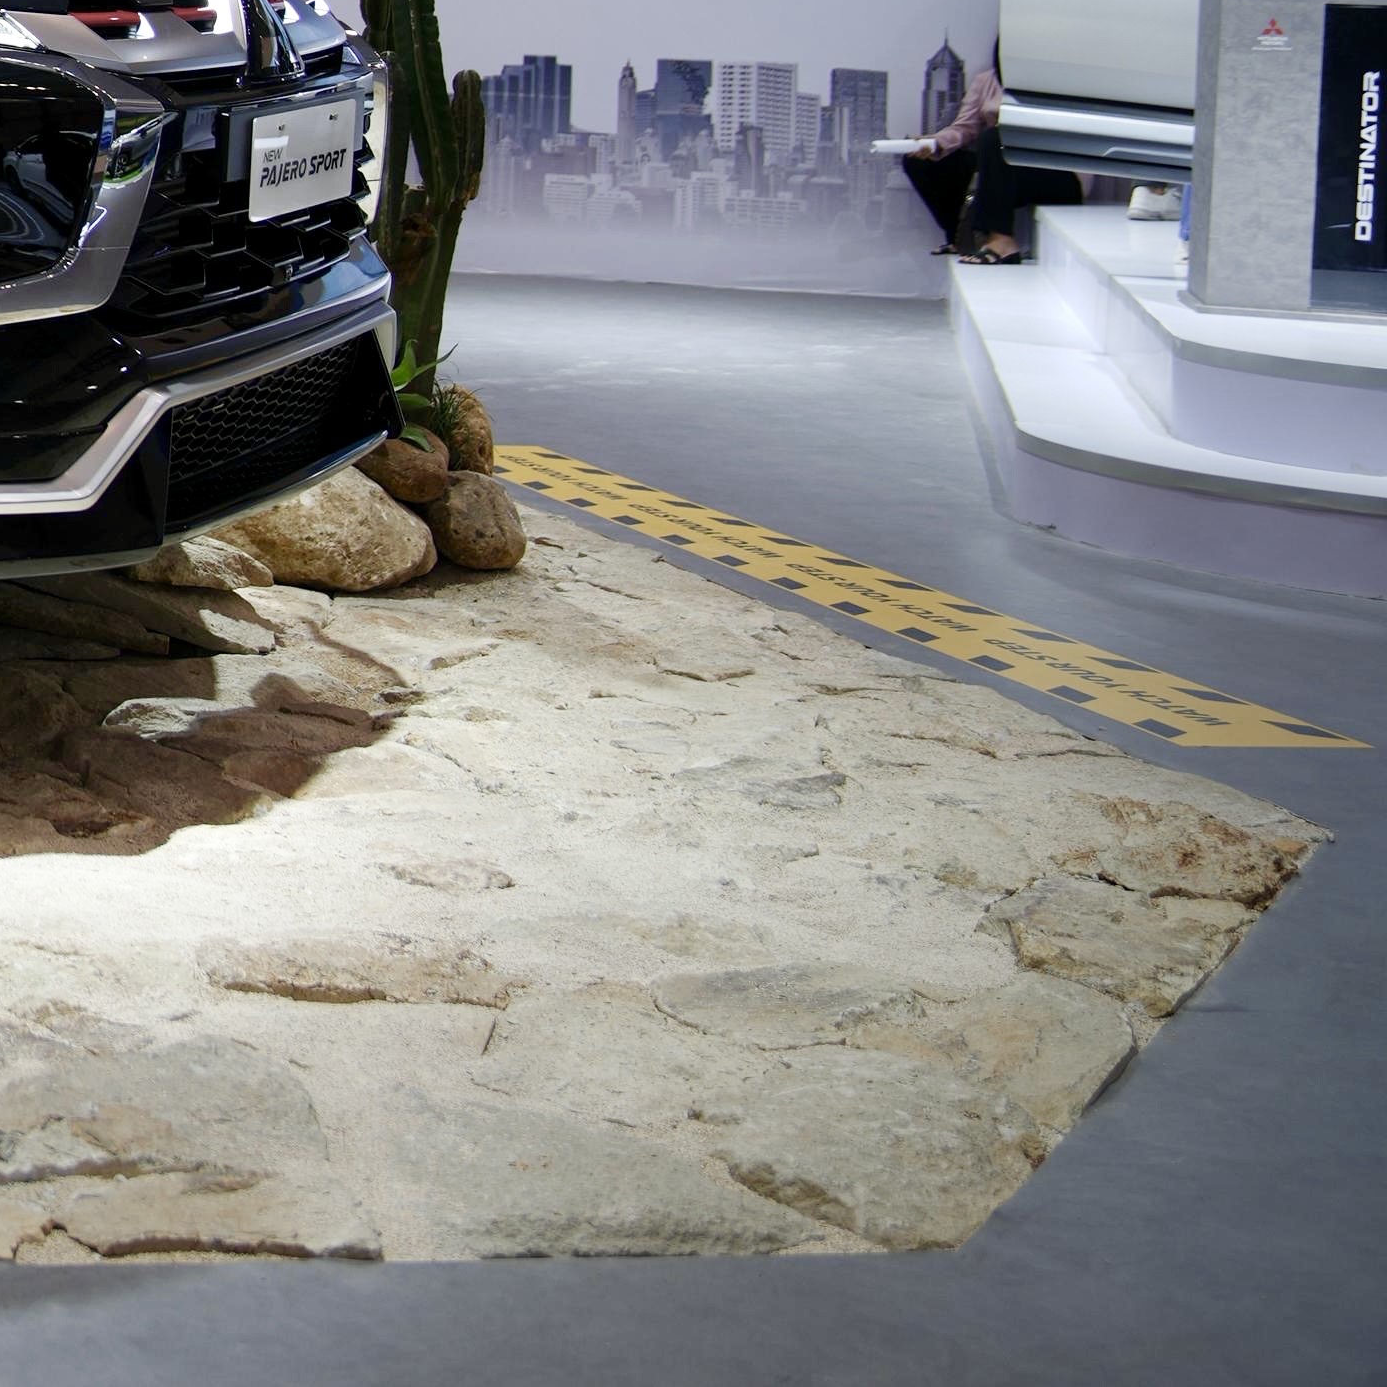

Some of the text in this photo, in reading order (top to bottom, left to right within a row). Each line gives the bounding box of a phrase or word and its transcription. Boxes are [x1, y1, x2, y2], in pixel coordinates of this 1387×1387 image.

[260, 149, 347, 187] PAJERO SPORT
[263, 149, 283, 163] NEW
[1354, 70, 1381, 242] DESTINATOR
[667, 518, 722, 535] YOUR
[713, 535, 784, 558] WATCH
[785, 563, 979, 632] WATCH YOUR STEP
[983, 638, 1234, 726] WATCH YOUR STEP
